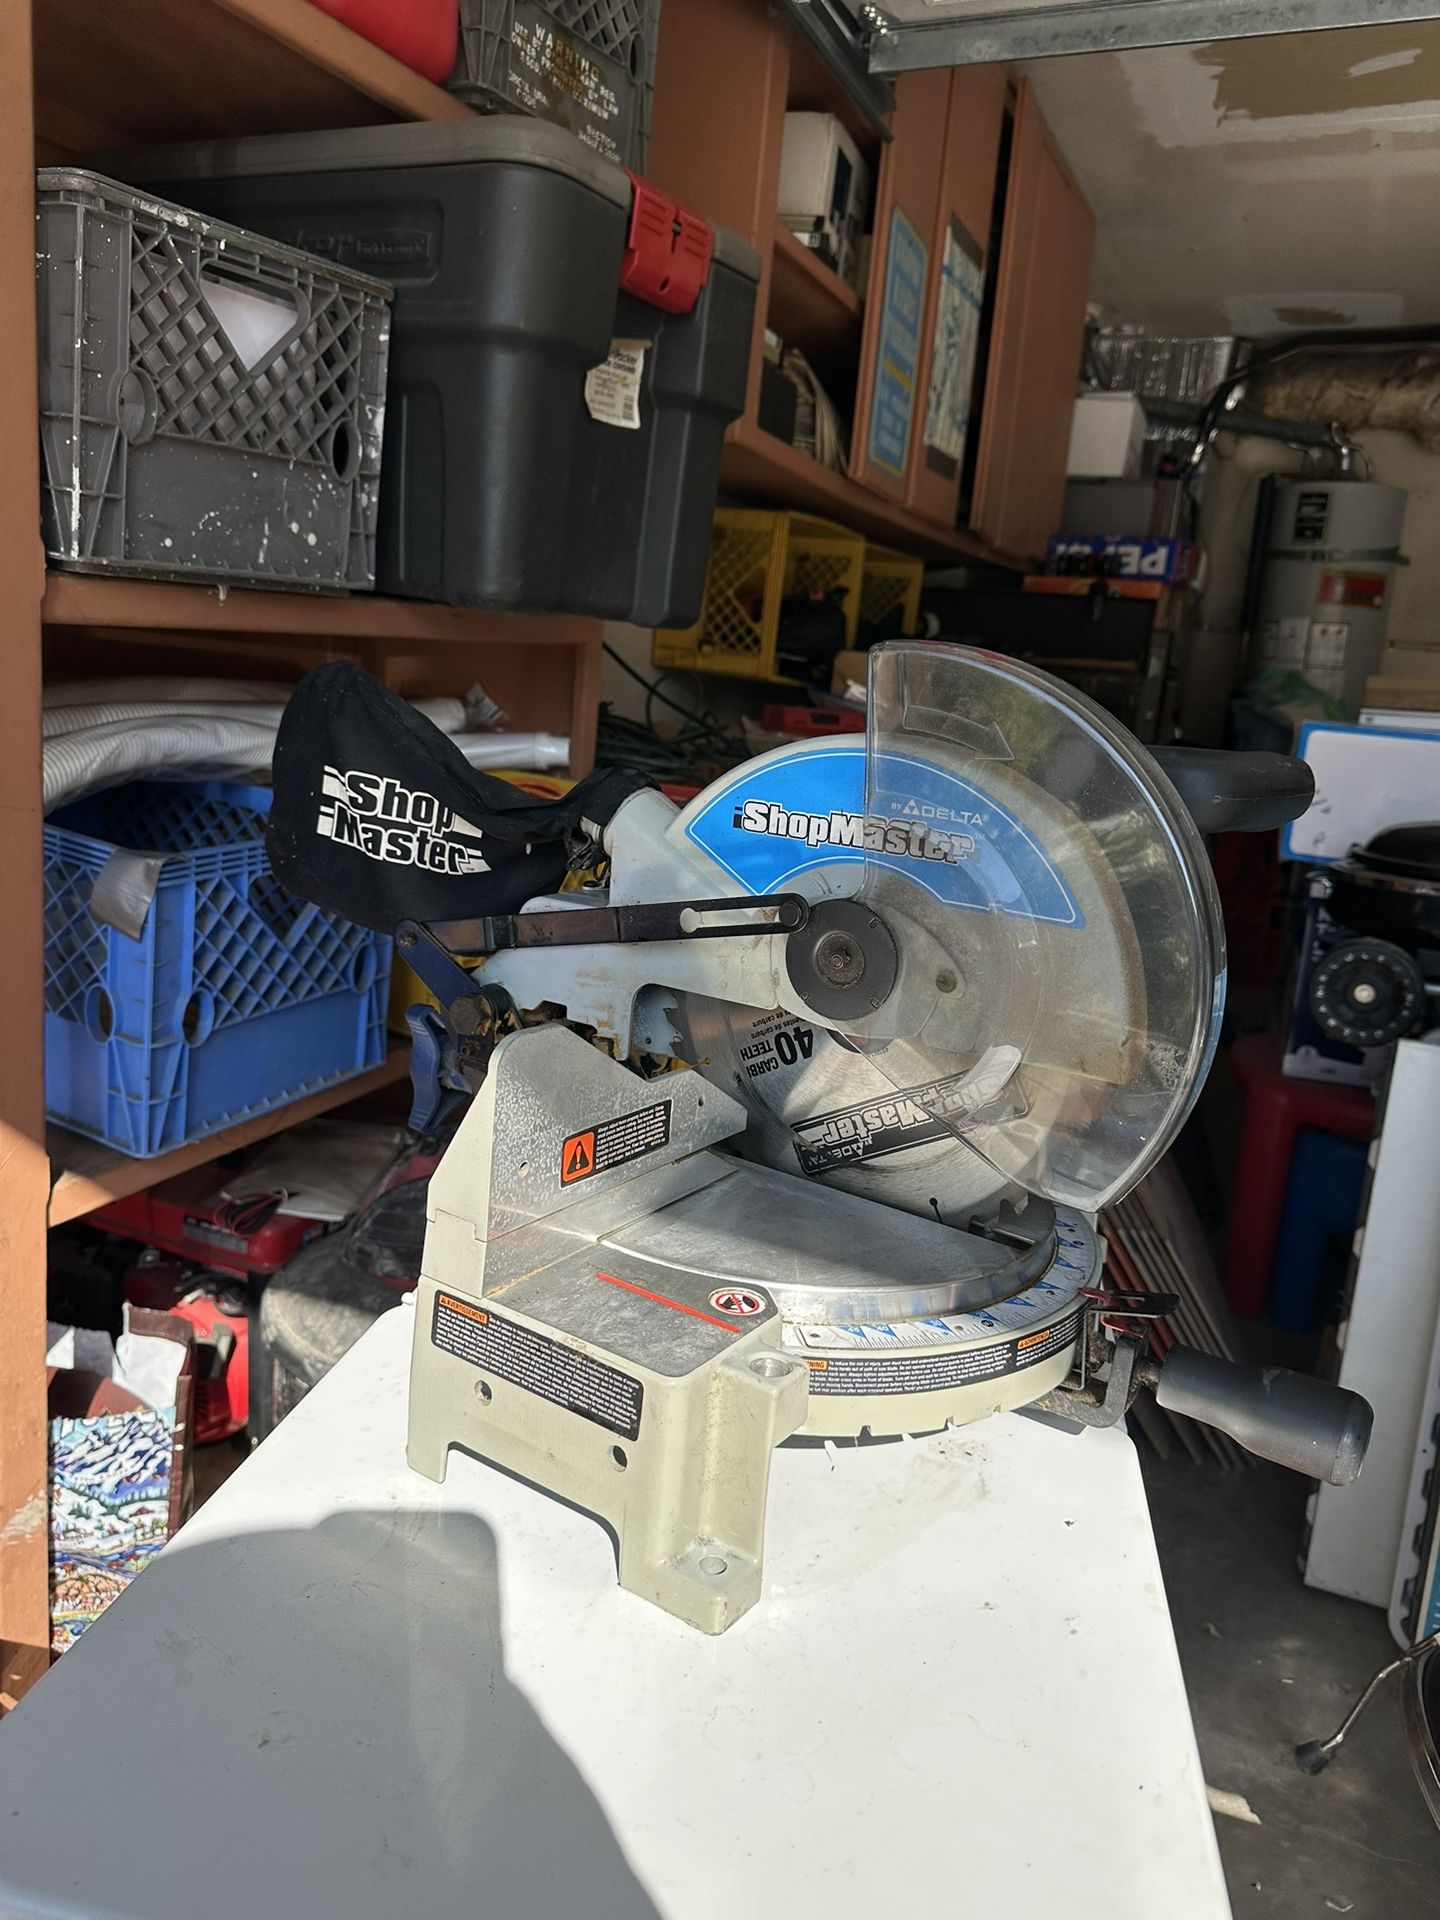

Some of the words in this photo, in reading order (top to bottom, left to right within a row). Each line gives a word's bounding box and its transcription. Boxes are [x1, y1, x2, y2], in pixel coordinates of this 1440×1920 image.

[345, 770, 457, 838] Shop
[890, 802, 902, 811] BY
[919, 806, 983, 826] DELTA
[331, 800, 471, 876] Master
[742, 798, 976, 868] ShopMaster
[740, 1040, 774, 1061] TEETH
[774, 1026, 814, 1066] 40
